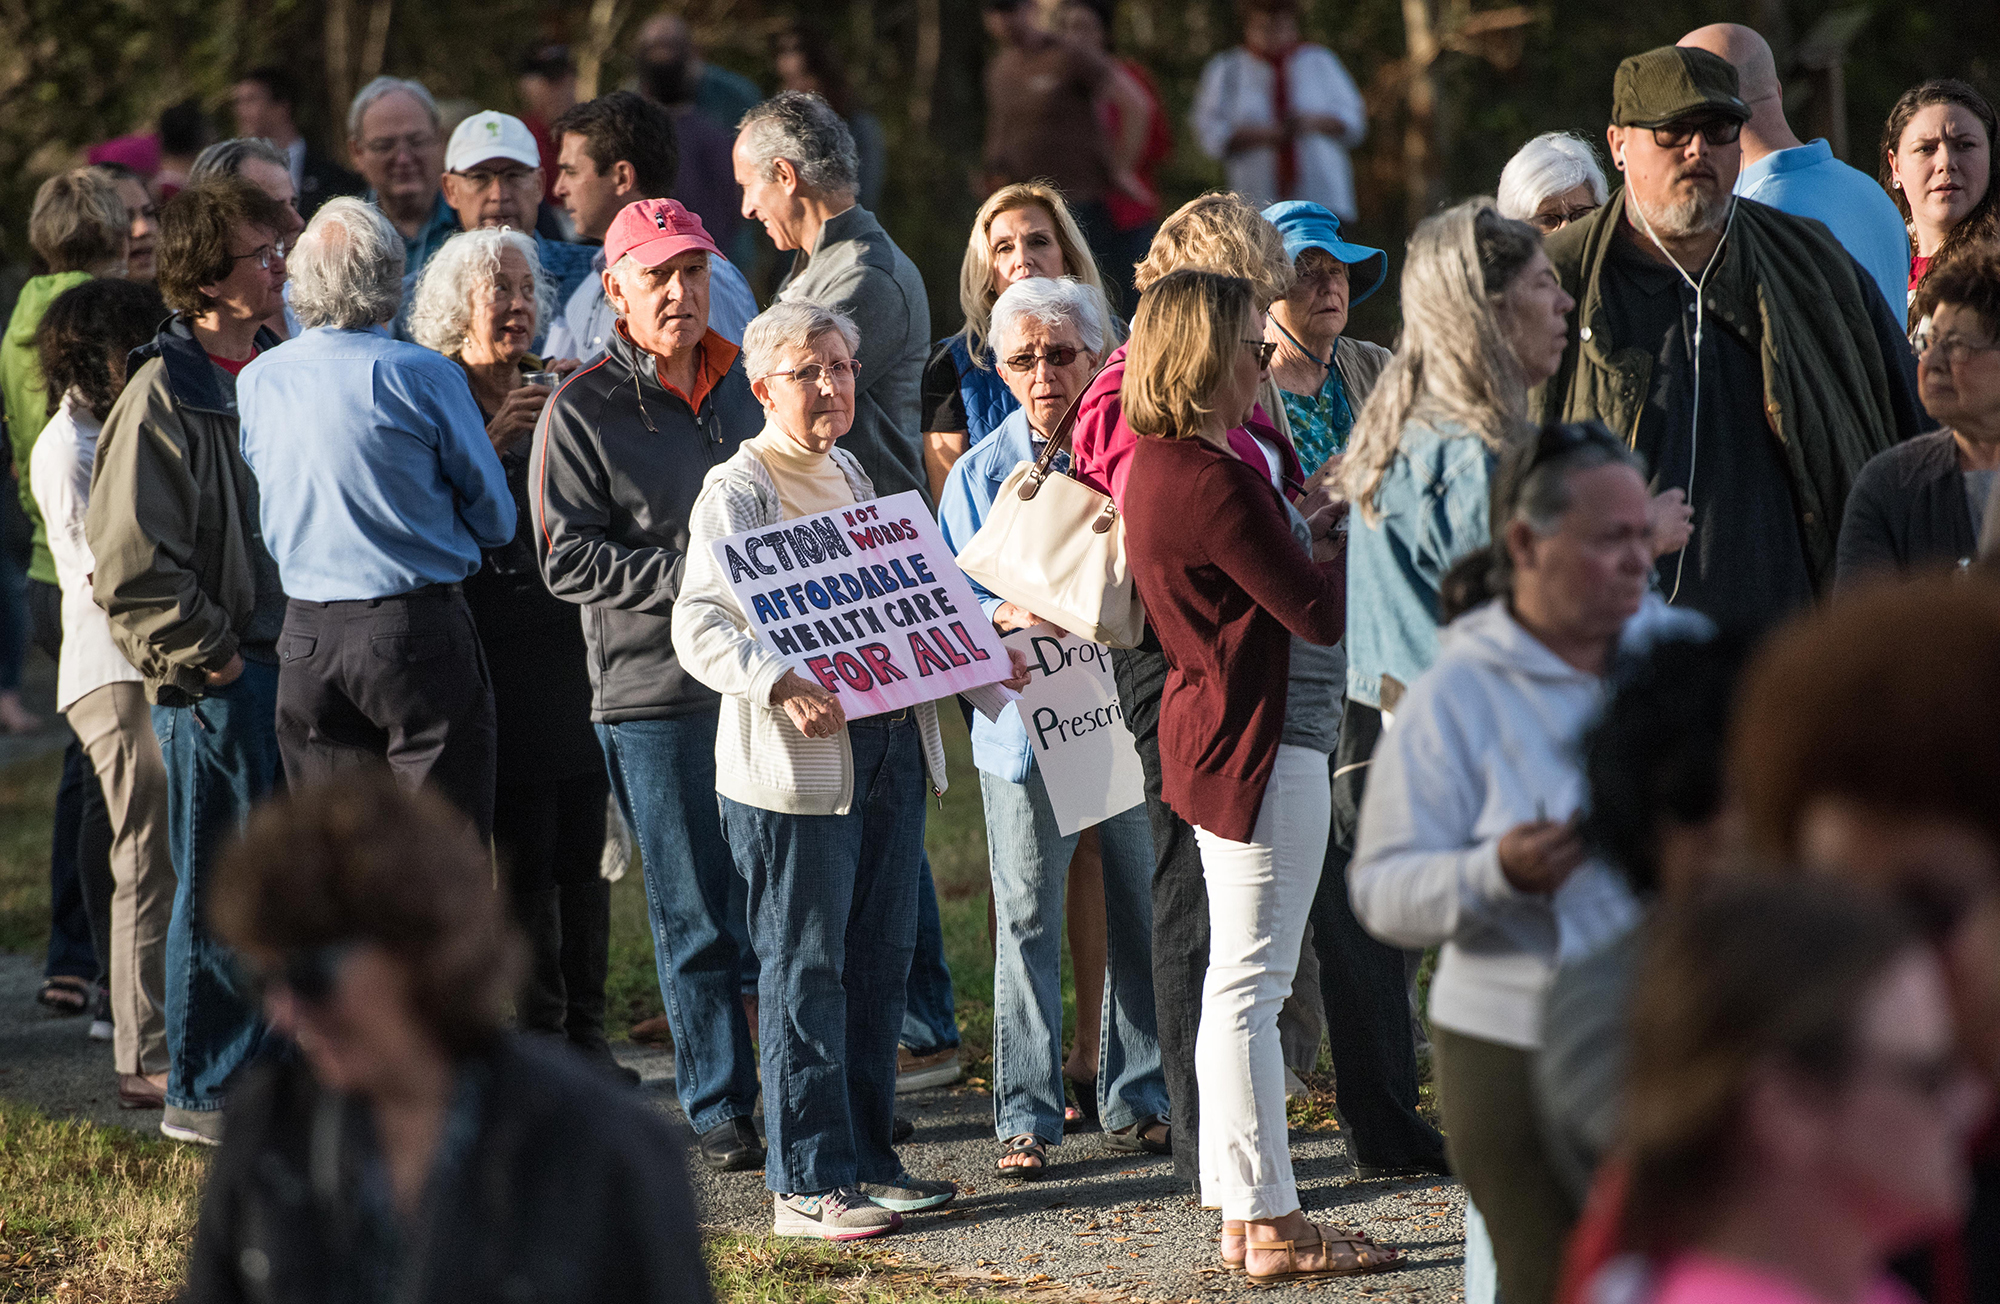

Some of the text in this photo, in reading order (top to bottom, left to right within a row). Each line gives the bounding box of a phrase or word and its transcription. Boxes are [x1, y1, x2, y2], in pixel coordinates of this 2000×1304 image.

[725, 516, 852, 584] ACTION
[842, 505, 879, 527] NOT
[847, 518, 918, 551] WORDS
[751, 553, 937, 625] AFFORDABLE
[768, 587, 958, 656] HEALTH CARE
[803, 620, 991, 694] FOR ALL
